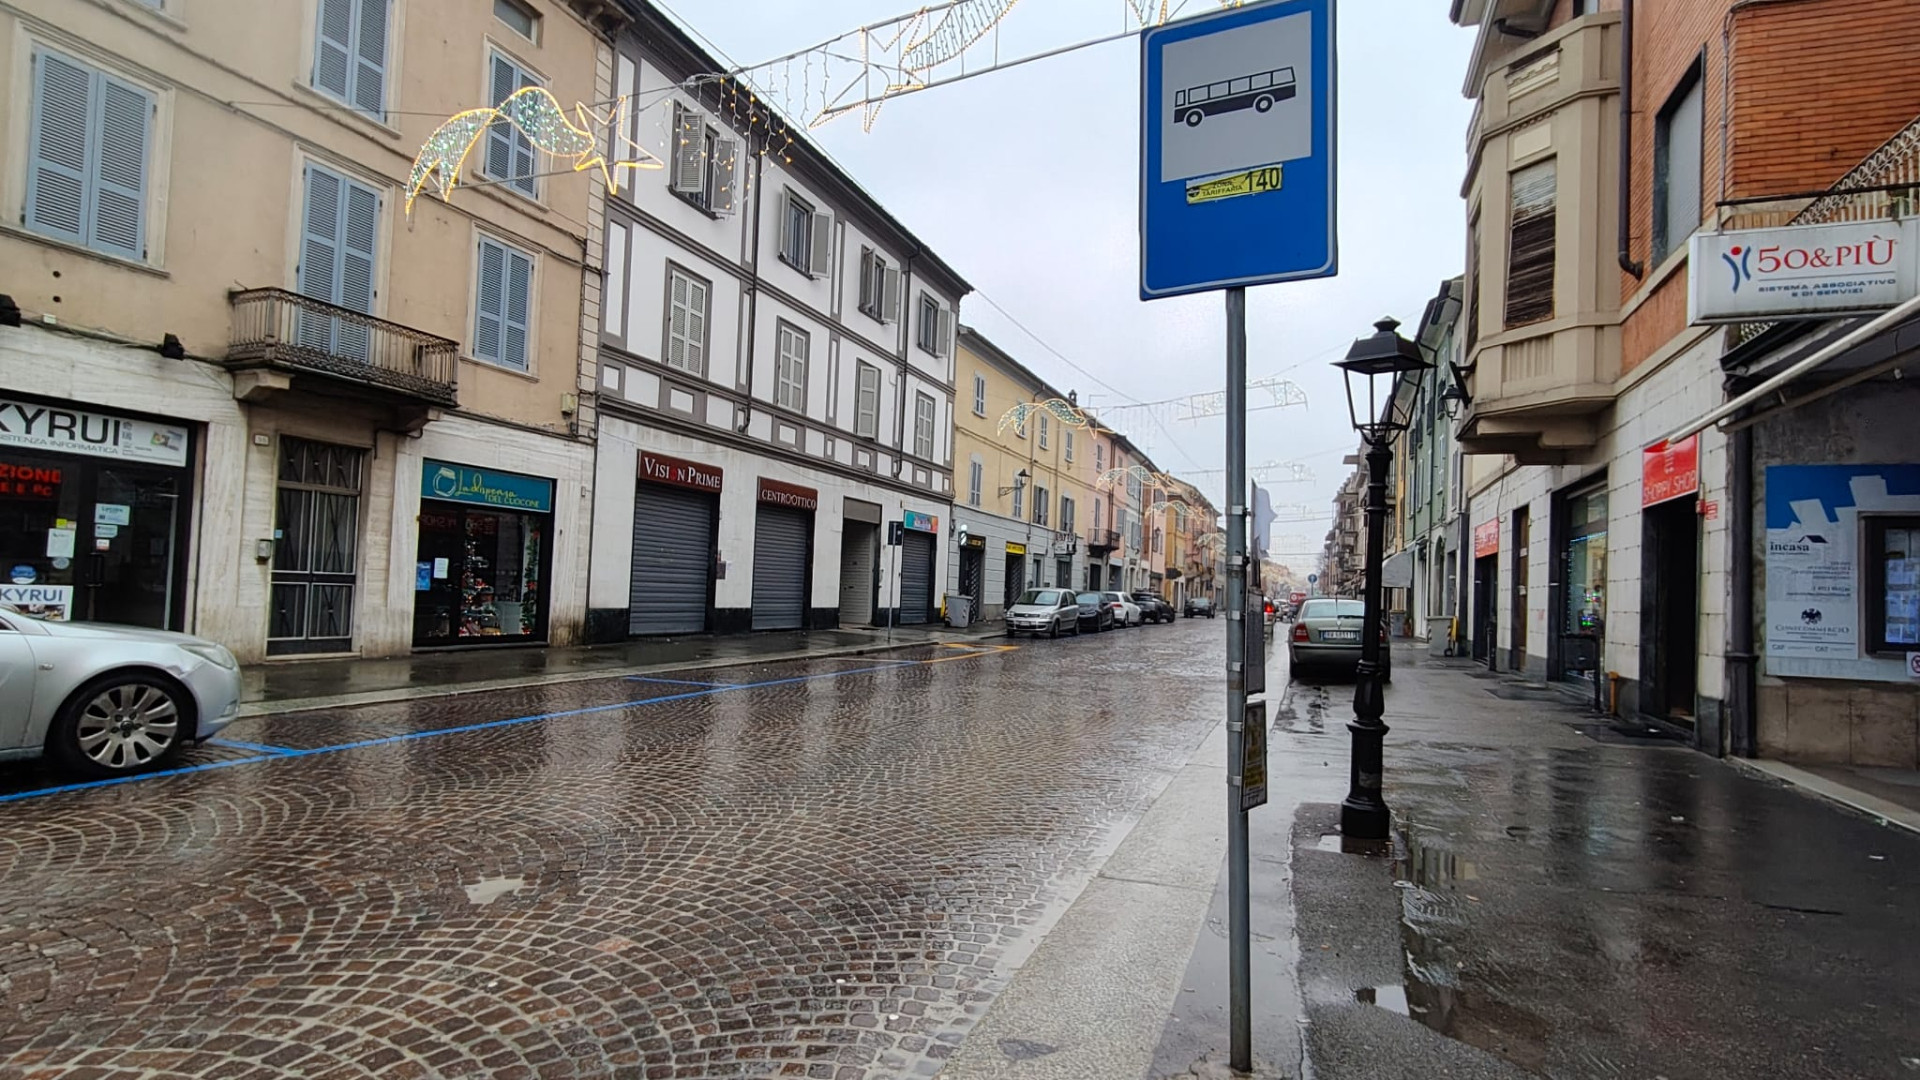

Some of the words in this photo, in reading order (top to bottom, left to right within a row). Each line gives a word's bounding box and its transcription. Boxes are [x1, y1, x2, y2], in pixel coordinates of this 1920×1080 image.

[1245, 168, 1280, 192] 140
[1202, 185, 1243, 197] TARIFFARIA
[1757, 234, 1896, 273] 50&PIÙ
[1758, 283, 1808, 292] SISTEMA
[1812, 278, 1896, 289] ASSOCIATIVO
[50, 440, 118, 455] INFORMATICA
[687, 466, 720, 488] PRIME
[1672, 469, 1697, 494] SHOP
[1770, 542, 1810, 551] incasa
